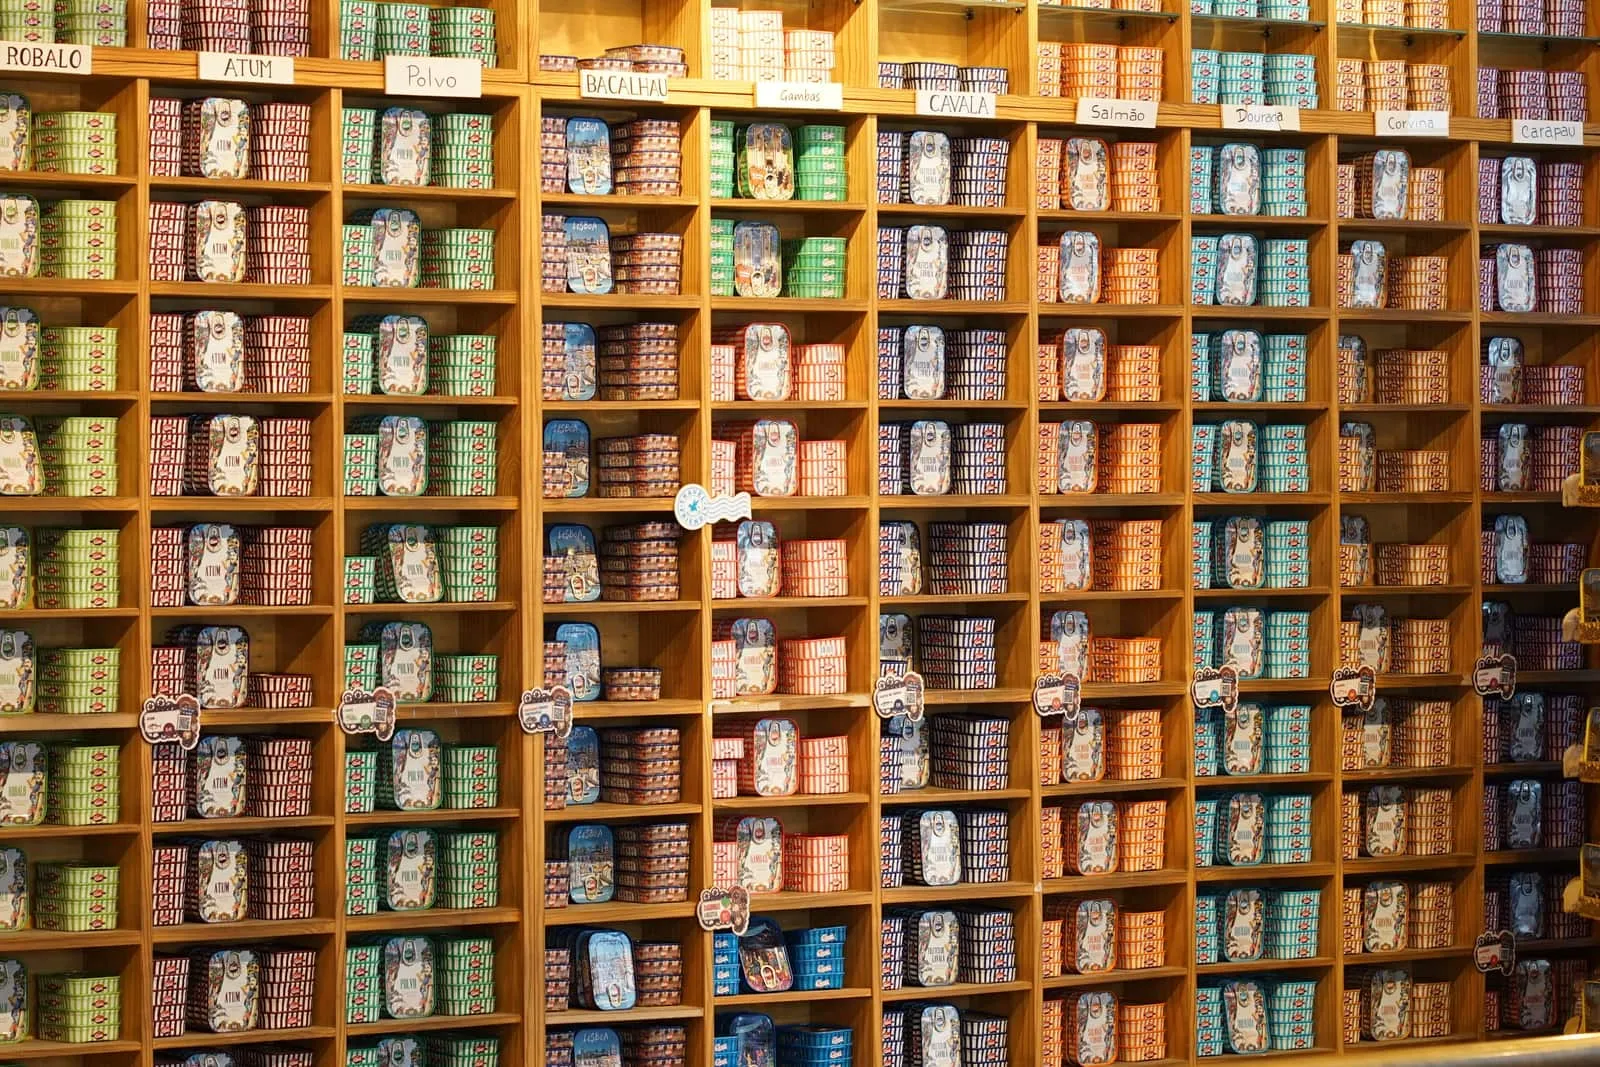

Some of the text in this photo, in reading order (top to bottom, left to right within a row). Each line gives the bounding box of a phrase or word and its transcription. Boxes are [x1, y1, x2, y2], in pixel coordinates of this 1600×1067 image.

[6, 46, 82, 69] ROBALO
[224, 58, 272, 79] ATUM
[407, 65, 457, 89] Polvo
[586, 74, 667, 97] BACALHAU
[780, 89, 820, 103] Gambas
[929, 94, 989, 115] CAVALA
[1091, 104, 1145, 122] Salmão
[1236, 108, 1283, 123] Dourada
[1387, 116, 1434, 130] Corvina
[1521, 124, 1576, 140] Carapau
[217, 139, 231, 151] ATUM
[213, 243, 228, 254] ATUM
[212, 353, 226, 364] ATUM
[225, 455, 240, 466] ATUM
[205, 565, 220, 576] ATUM
[214, 668, 228, 679] ATUM
[213, 777, 228, 789] ATUM
[215, 882, 229, 893] ATUM
[225, 991, 240, 1003] ATUM
